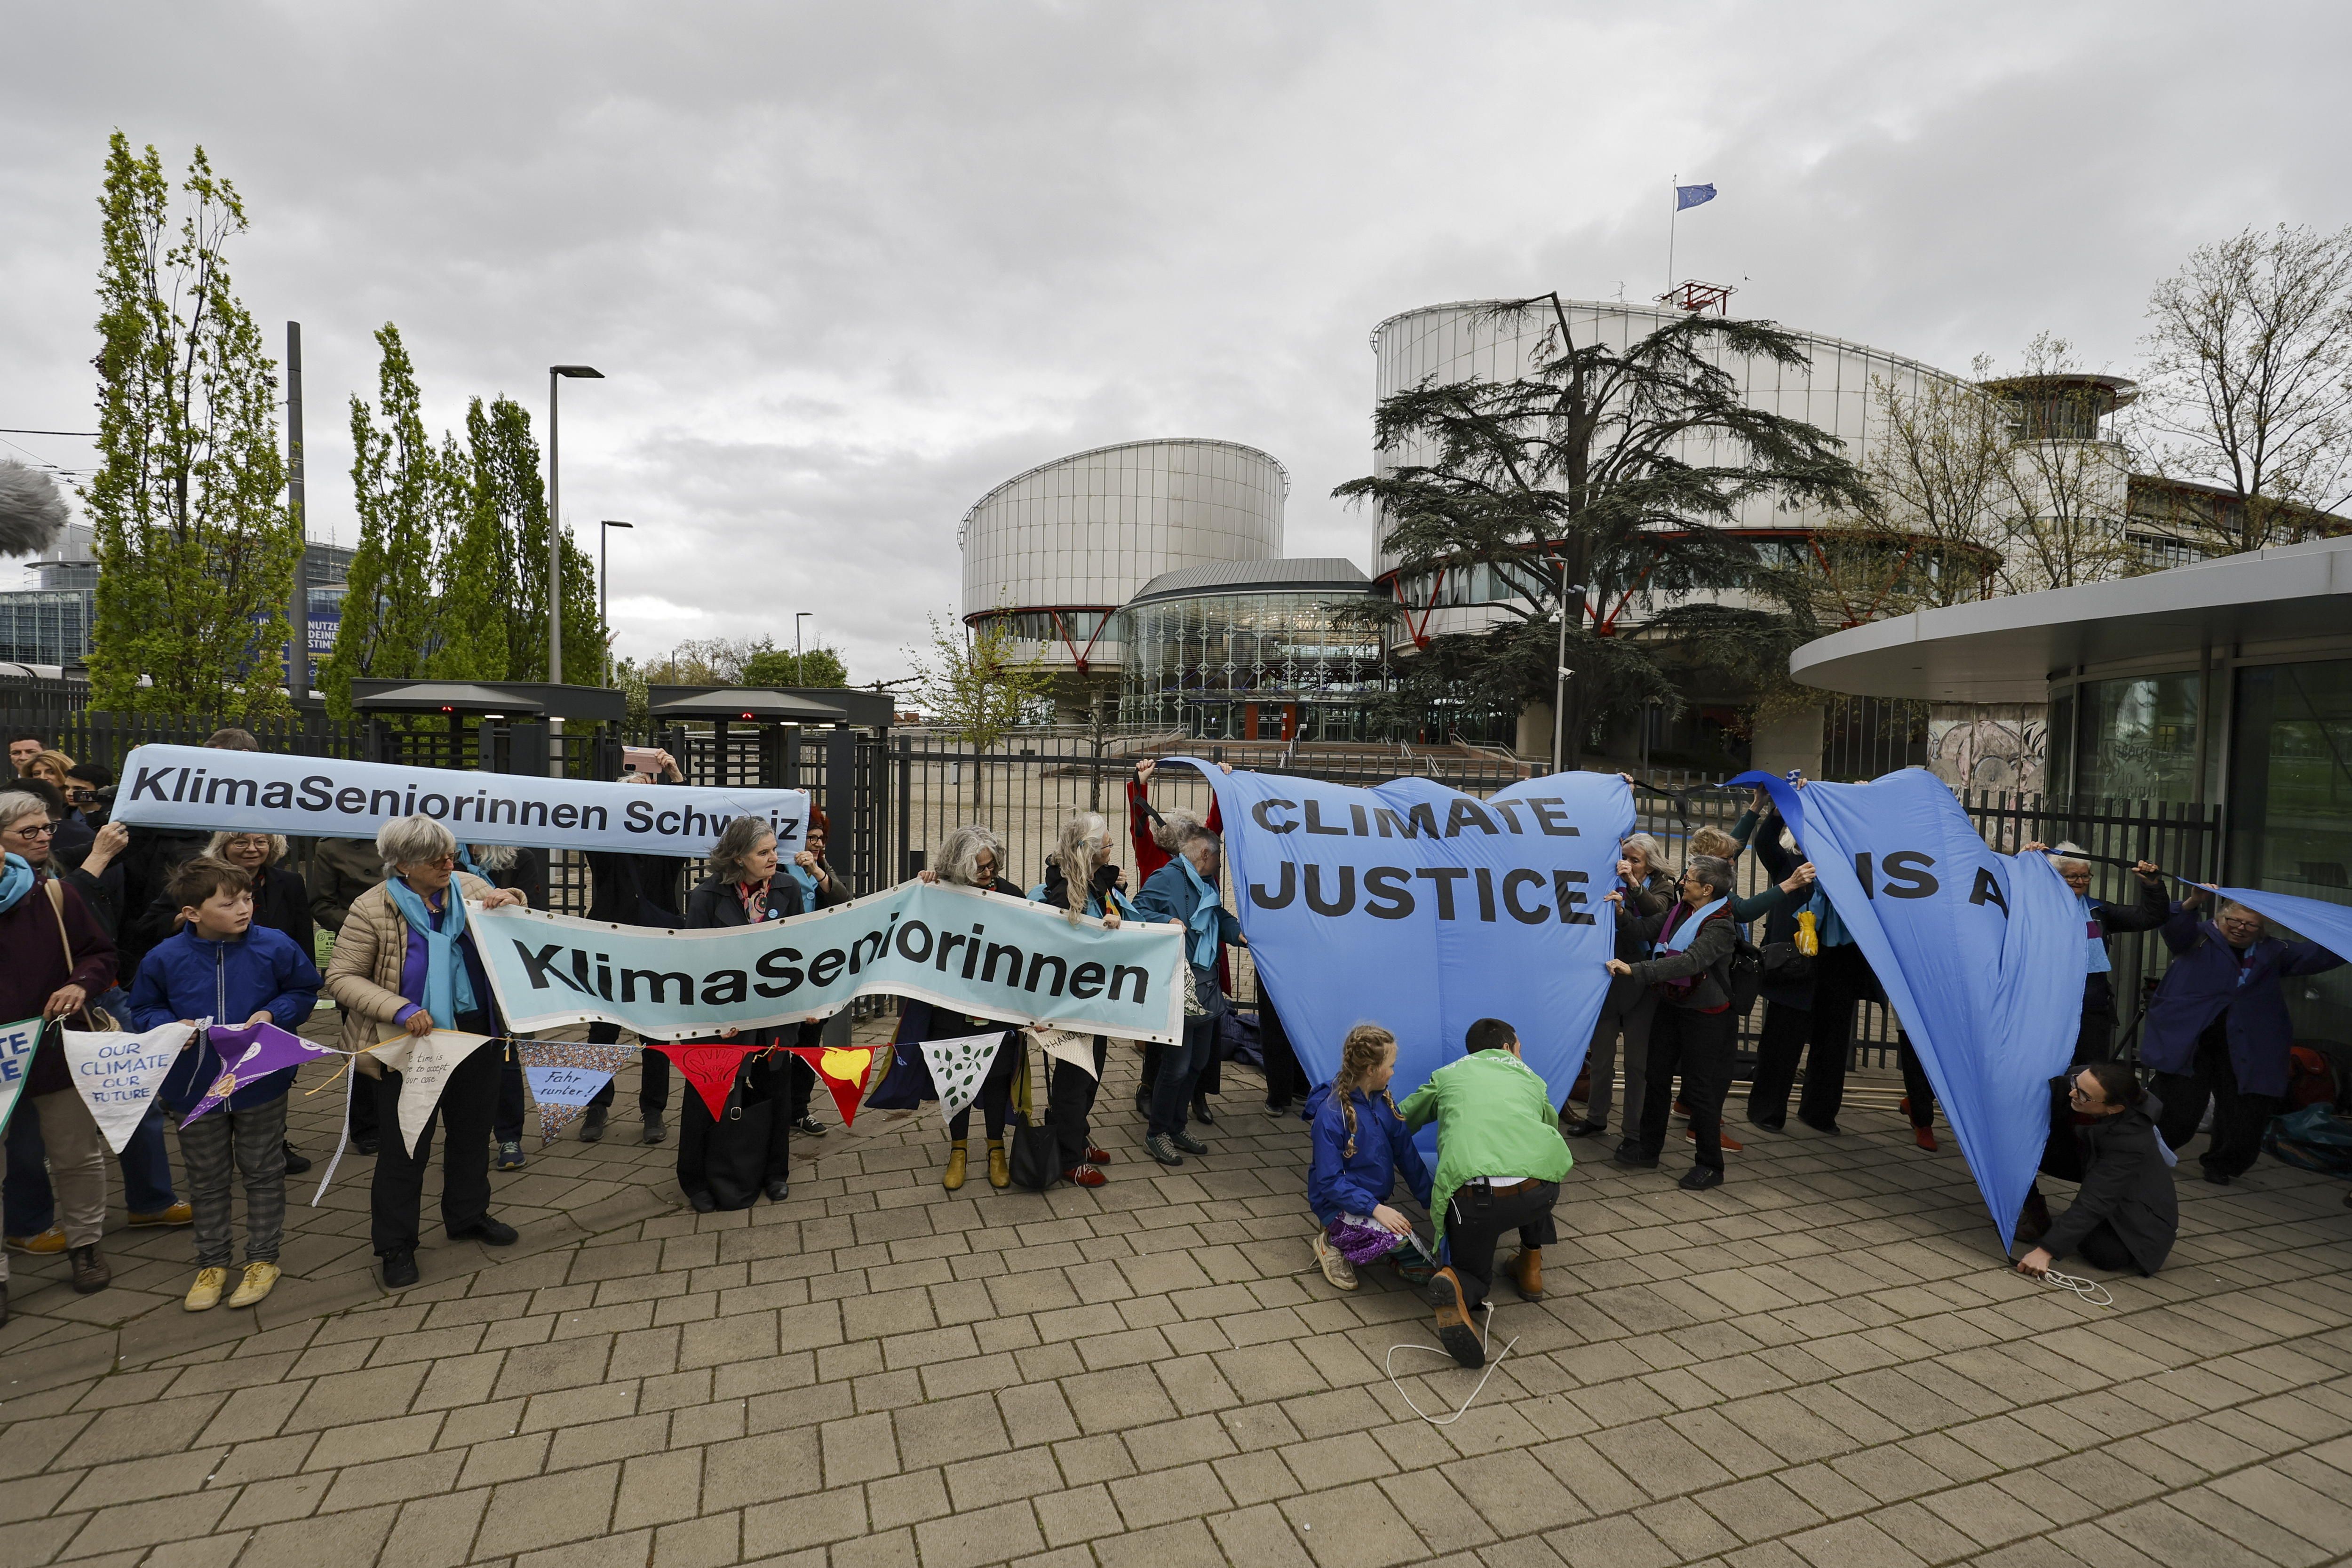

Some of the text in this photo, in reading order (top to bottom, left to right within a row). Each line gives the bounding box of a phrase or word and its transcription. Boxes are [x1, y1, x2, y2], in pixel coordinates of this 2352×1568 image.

[308, 621, 339, 631] NUTZE
[308, 630, 337, 641] DEINE
[130, 767, 799, 840] KlimaSeniorinnen Schwiz
[1251, 797, 1581, 840] CLIMATE
[1250, 860, 1596, 925] JUSTICE
[1855, 851, 2008, 921] IS A
[512, 912, 1149, 1005] KlimaSeniorinnen
[98, 1043, 141, 1059] OUR
[417, 1052, 433, 1063] time
[80, 1053, 170, 1076] CLIMATE
[426, 1063, 450, 1075] accept
[102, 1075, 140, 1088] OUR
[92, 1087, 151, 1102] FUTURE
